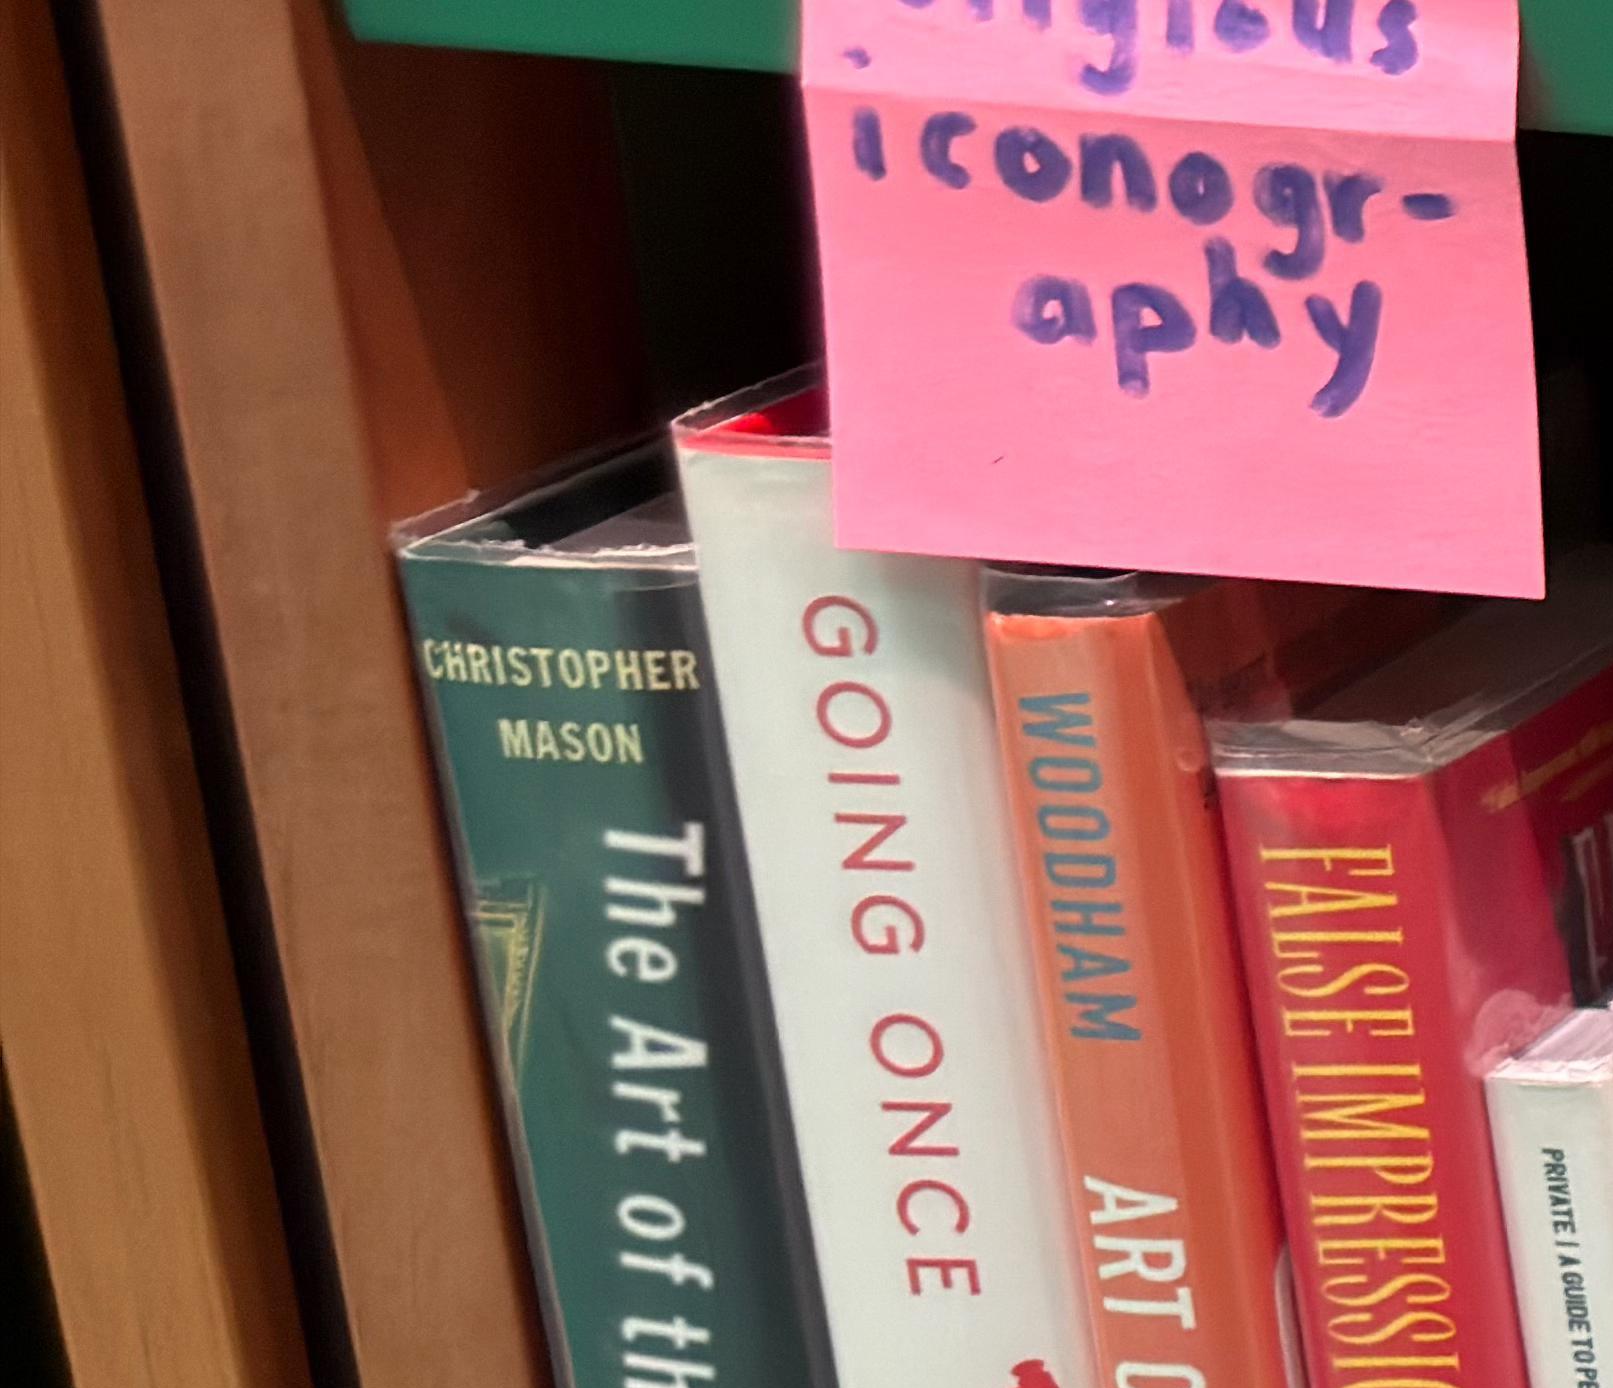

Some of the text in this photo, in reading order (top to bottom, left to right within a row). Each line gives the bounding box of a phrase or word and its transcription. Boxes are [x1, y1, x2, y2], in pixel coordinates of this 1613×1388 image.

[1011, 236, 1383, 418] aphy
[422, 638, 701, 691] CHRISTOPHER
[498, 719, 645, 764] MASON
[602, 822, 705, 983] The
[800, 595, 982, 1296] GOING ONCE
[1016, 692, 1143, 1043] WOODHAM
[1260, 844, 1414, 1037] FALSE
[610, 1015, 709, 1165] Art
[618, 1194, 713, 1290] of
[1081, 1174, 1196, 1330] ART
